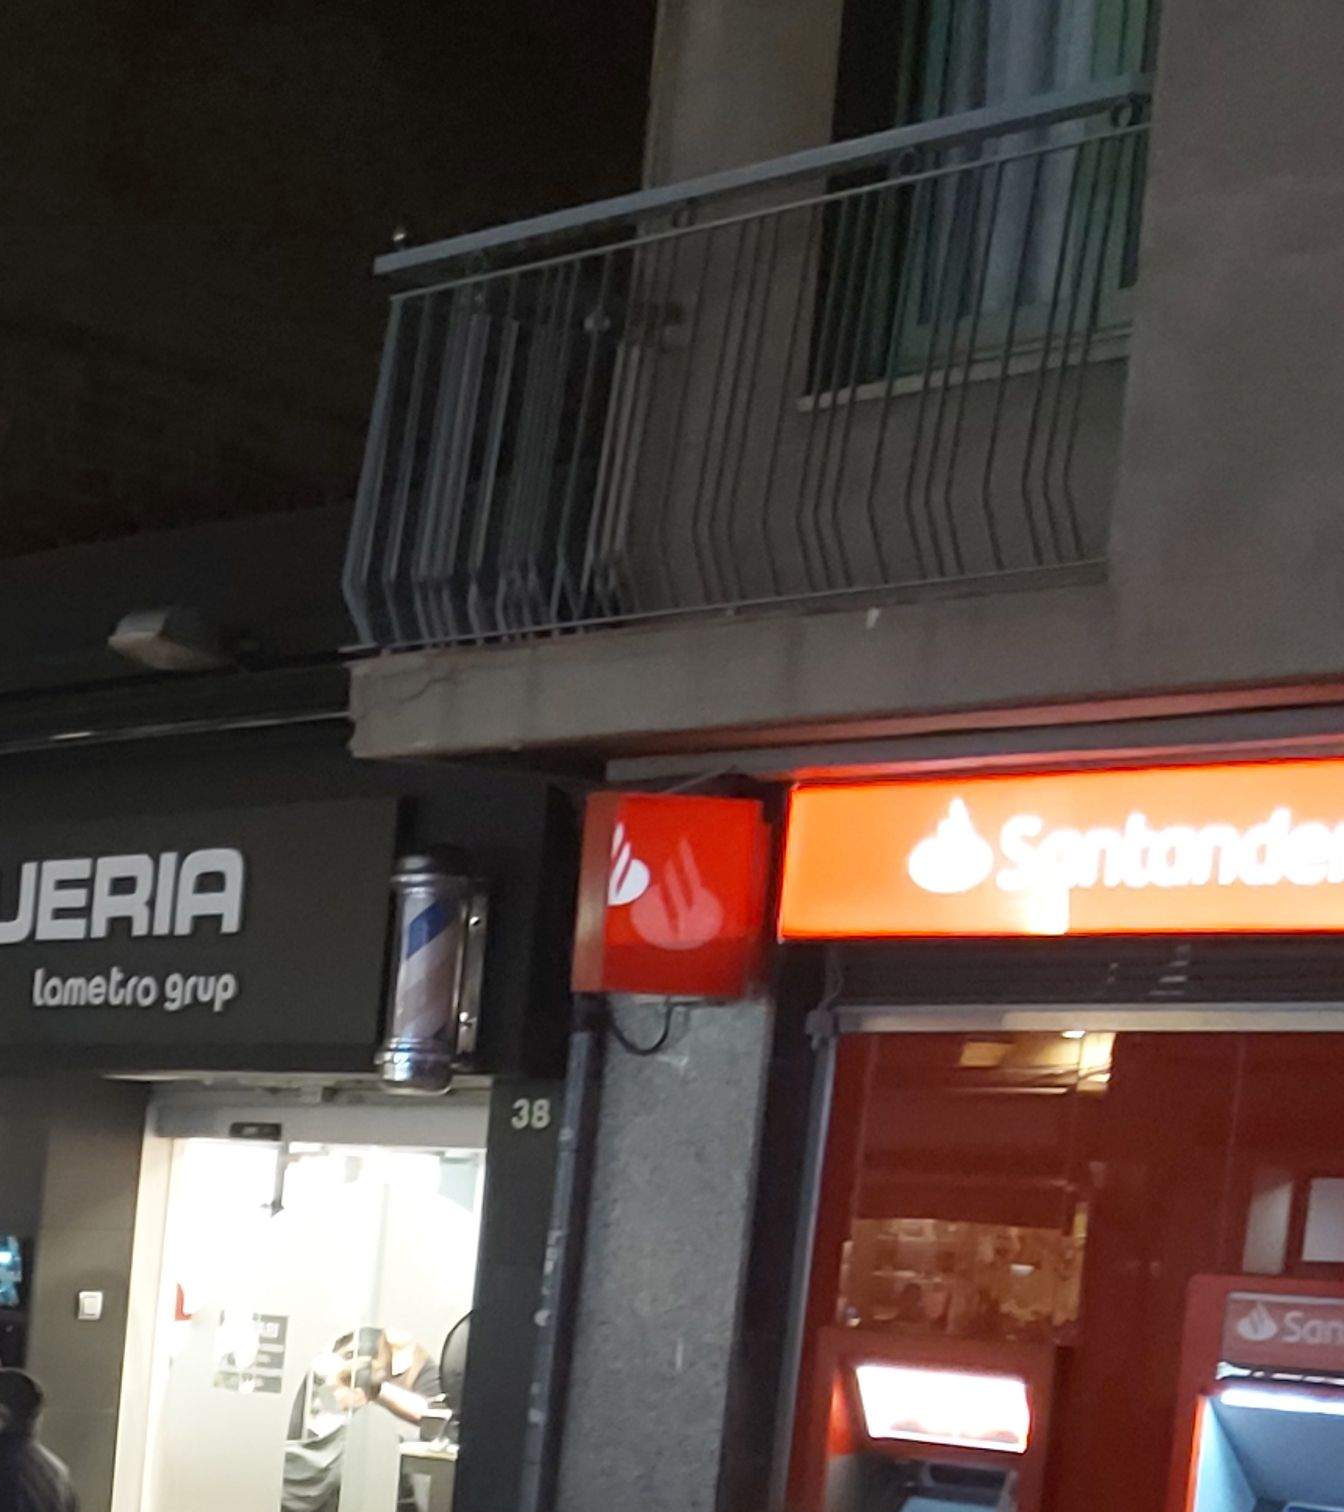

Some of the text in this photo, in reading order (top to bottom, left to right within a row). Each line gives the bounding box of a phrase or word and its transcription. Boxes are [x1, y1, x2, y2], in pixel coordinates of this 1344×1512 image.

[996, 805, 1344, 891] Santande
[33, 966, 238, 1012] lametro grup
[511, 1098, 551, 1130] 38
